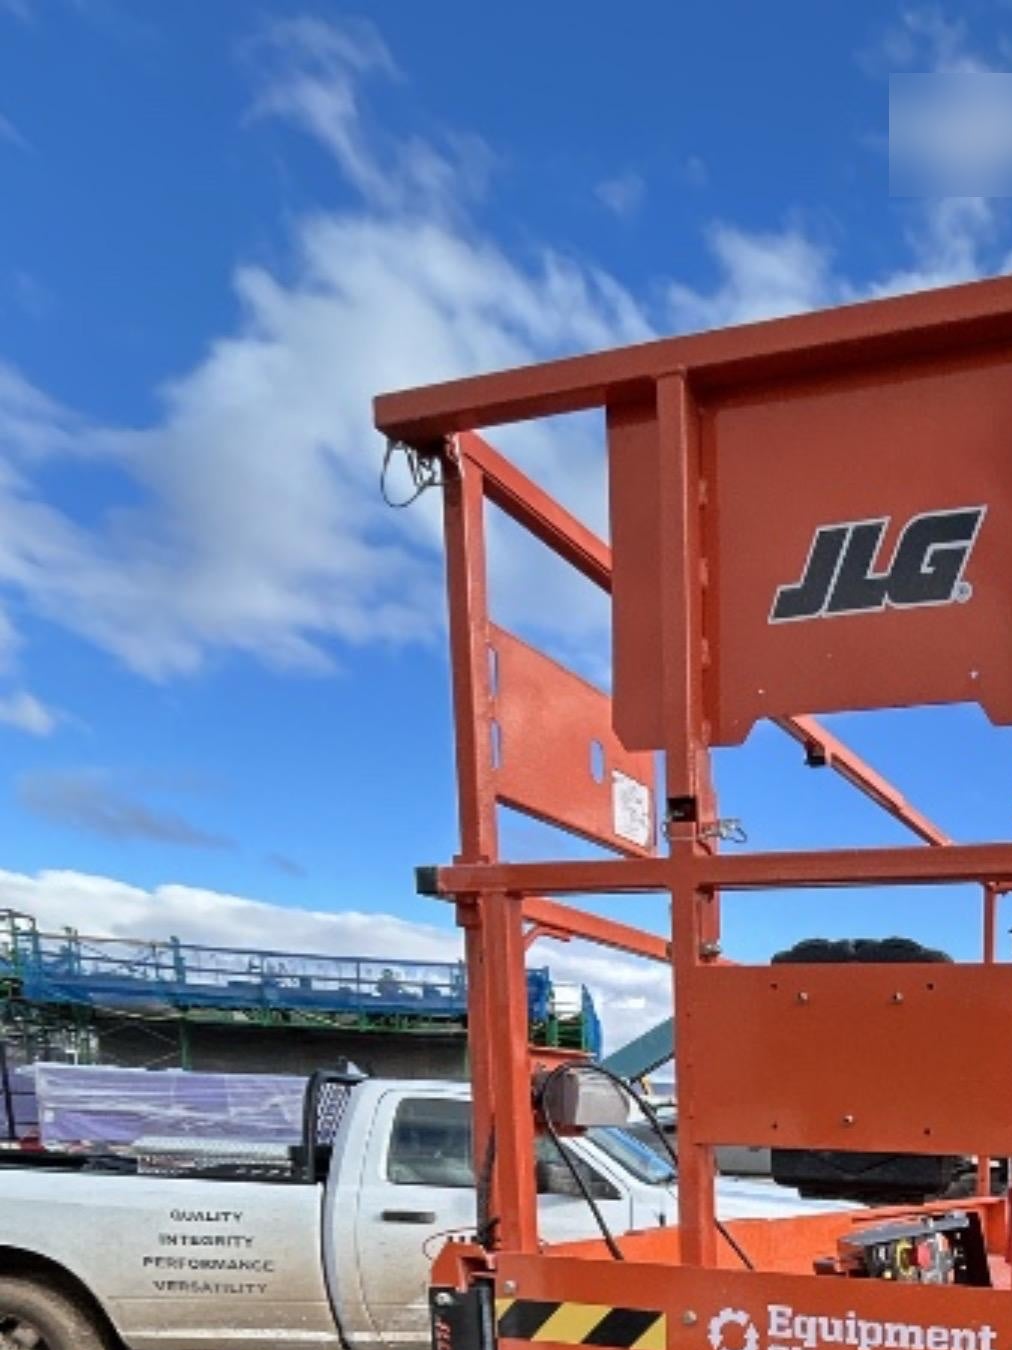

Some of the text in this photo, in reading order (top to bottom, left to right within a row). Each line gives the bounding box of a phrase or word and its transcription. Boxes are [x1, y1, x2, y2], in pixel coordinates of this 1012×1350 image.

[768, 504, 987, 624] JLG
[170, 1209, 243, 1222] QUALITY
[159, 1232, 254, 1247] INTEGRITY
[143, 1256, 275, 1272] PERFORMANCE
[152, 1280, 267, 1294] VERSATILITY
